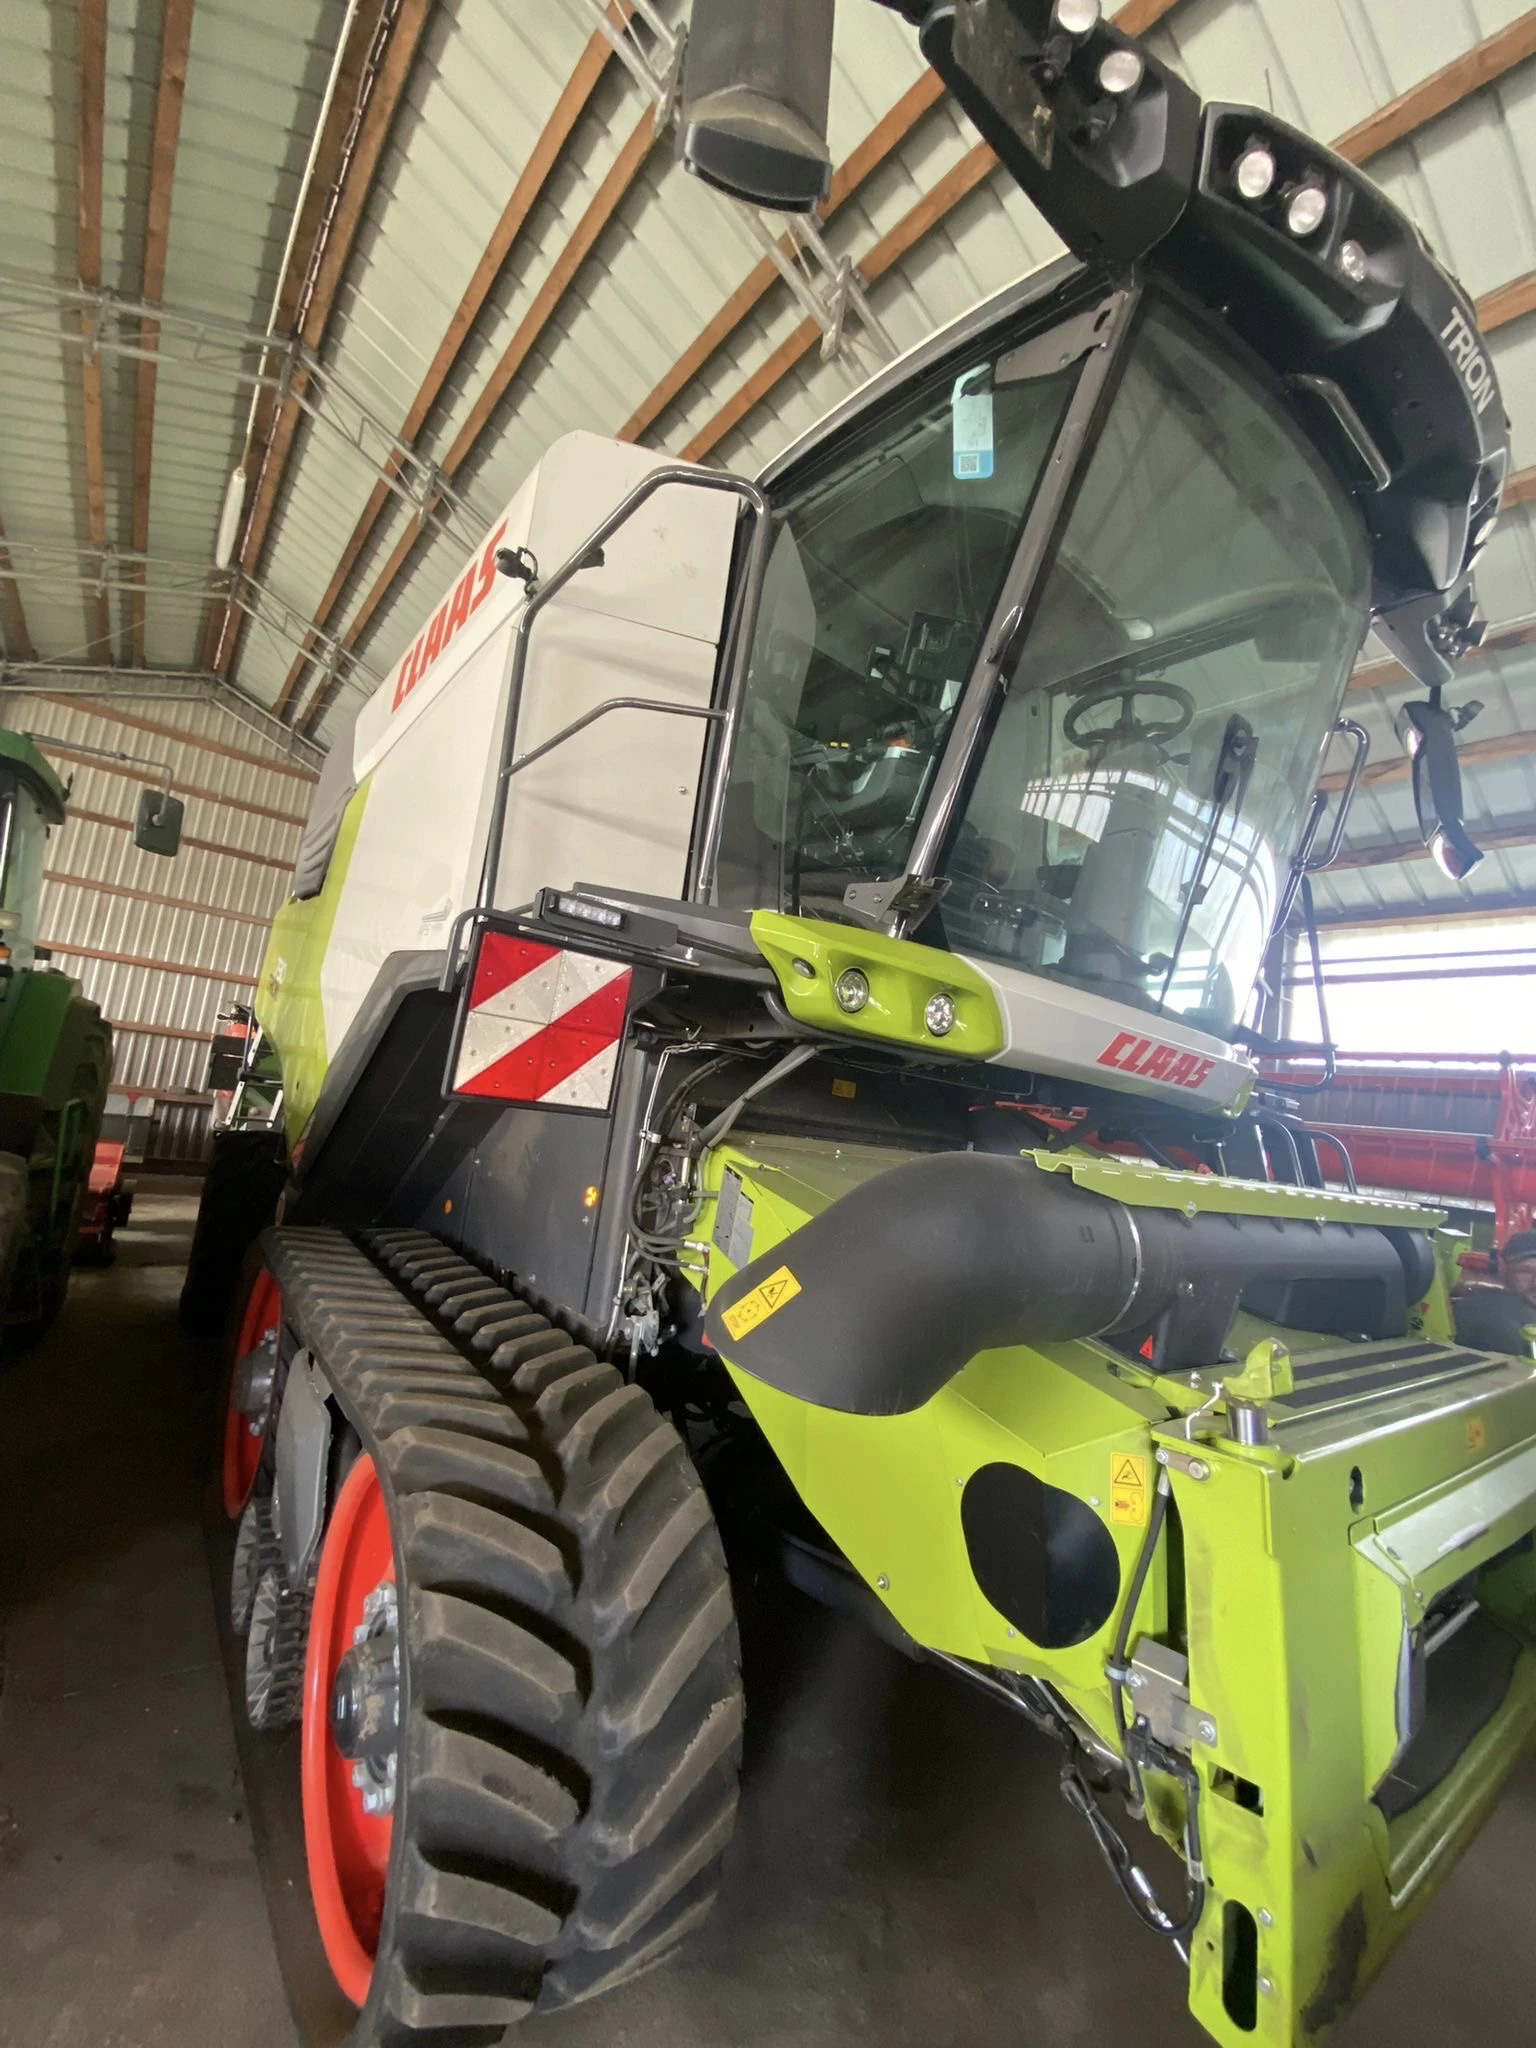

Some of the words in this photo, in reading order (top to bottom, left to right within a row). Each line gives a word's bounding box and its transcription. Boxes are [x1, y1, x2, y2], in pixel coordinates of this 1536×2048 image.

[1440, 306, 1495, 414] TRION
[391, 517, 509, 714] CLAAS
[1097, 1031, 1216, 1088] CLAAS
